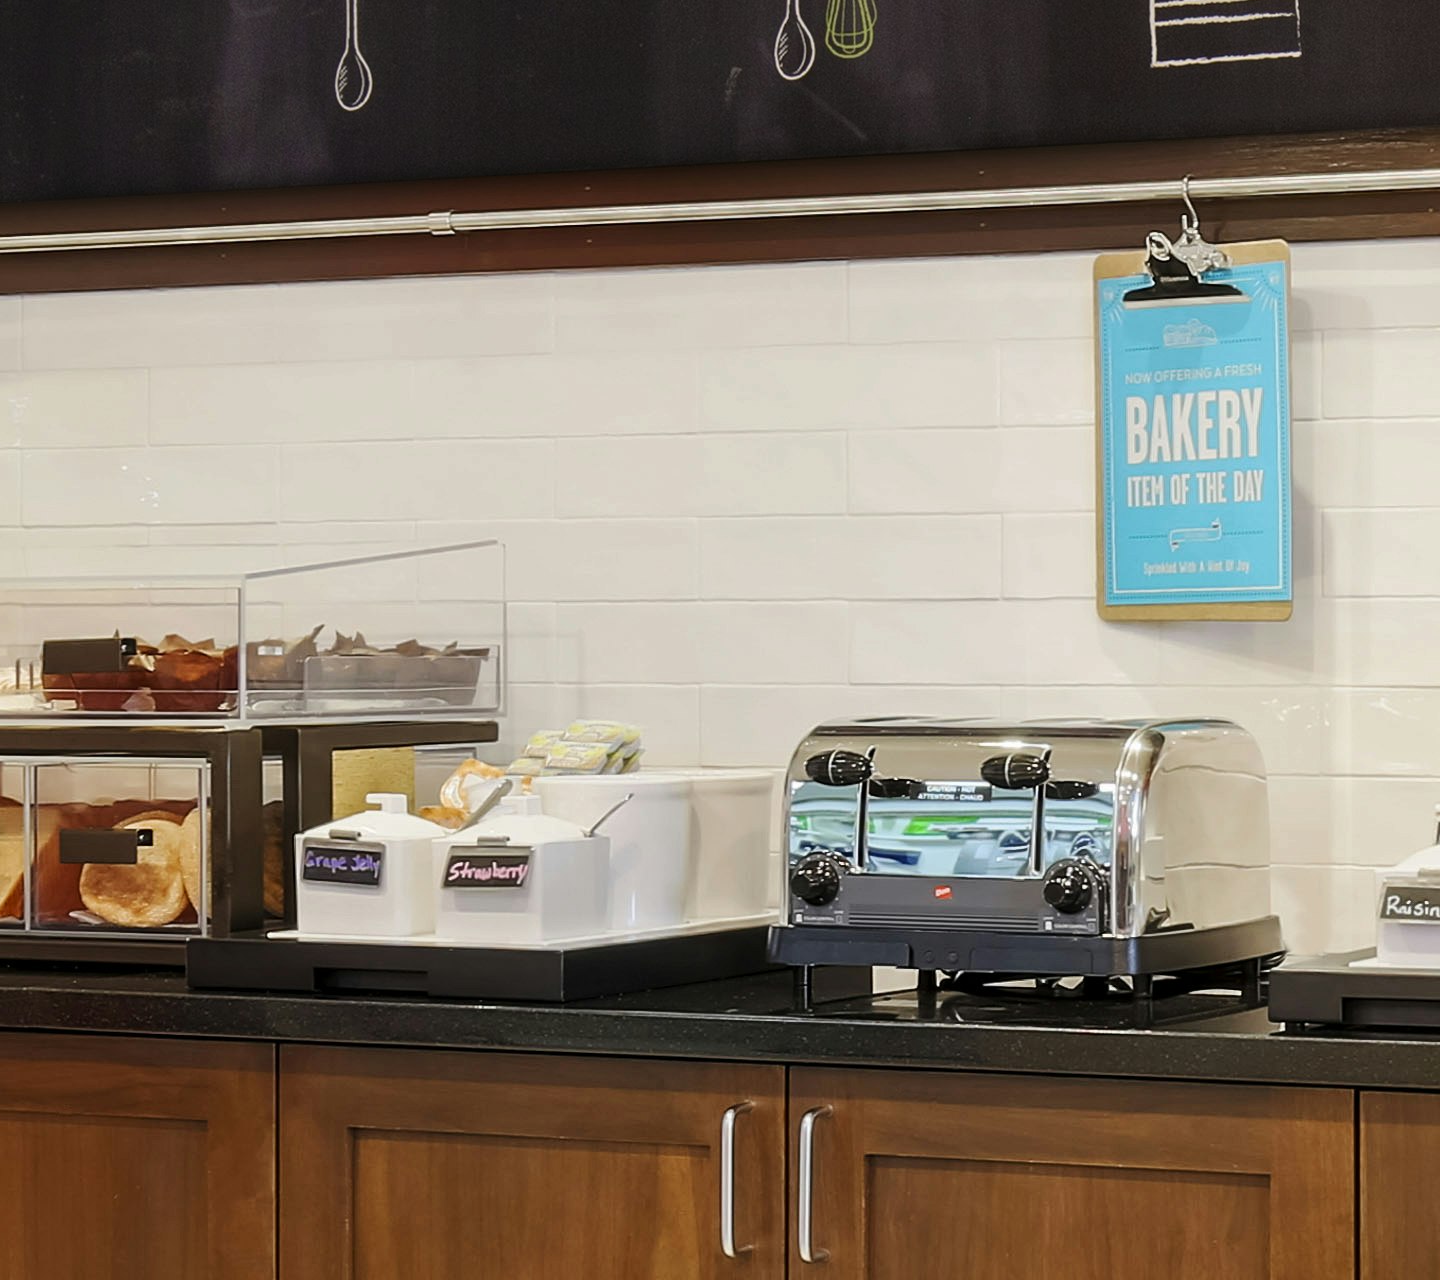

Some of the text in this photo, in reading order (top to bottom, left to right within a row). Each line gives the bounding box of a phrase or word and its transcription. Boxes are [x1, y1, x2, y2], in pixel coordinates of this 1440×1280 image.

[1125, 363, 1262, 384] NOW OFFERING A FRESH
[1126, 387, 1263, 465] BAKERY
[1127, 469, 1264, 507] ITEM OF THE DAY
[305, 850, 347, 873] Grape
[448, 862, 529, 885] Strawberry
